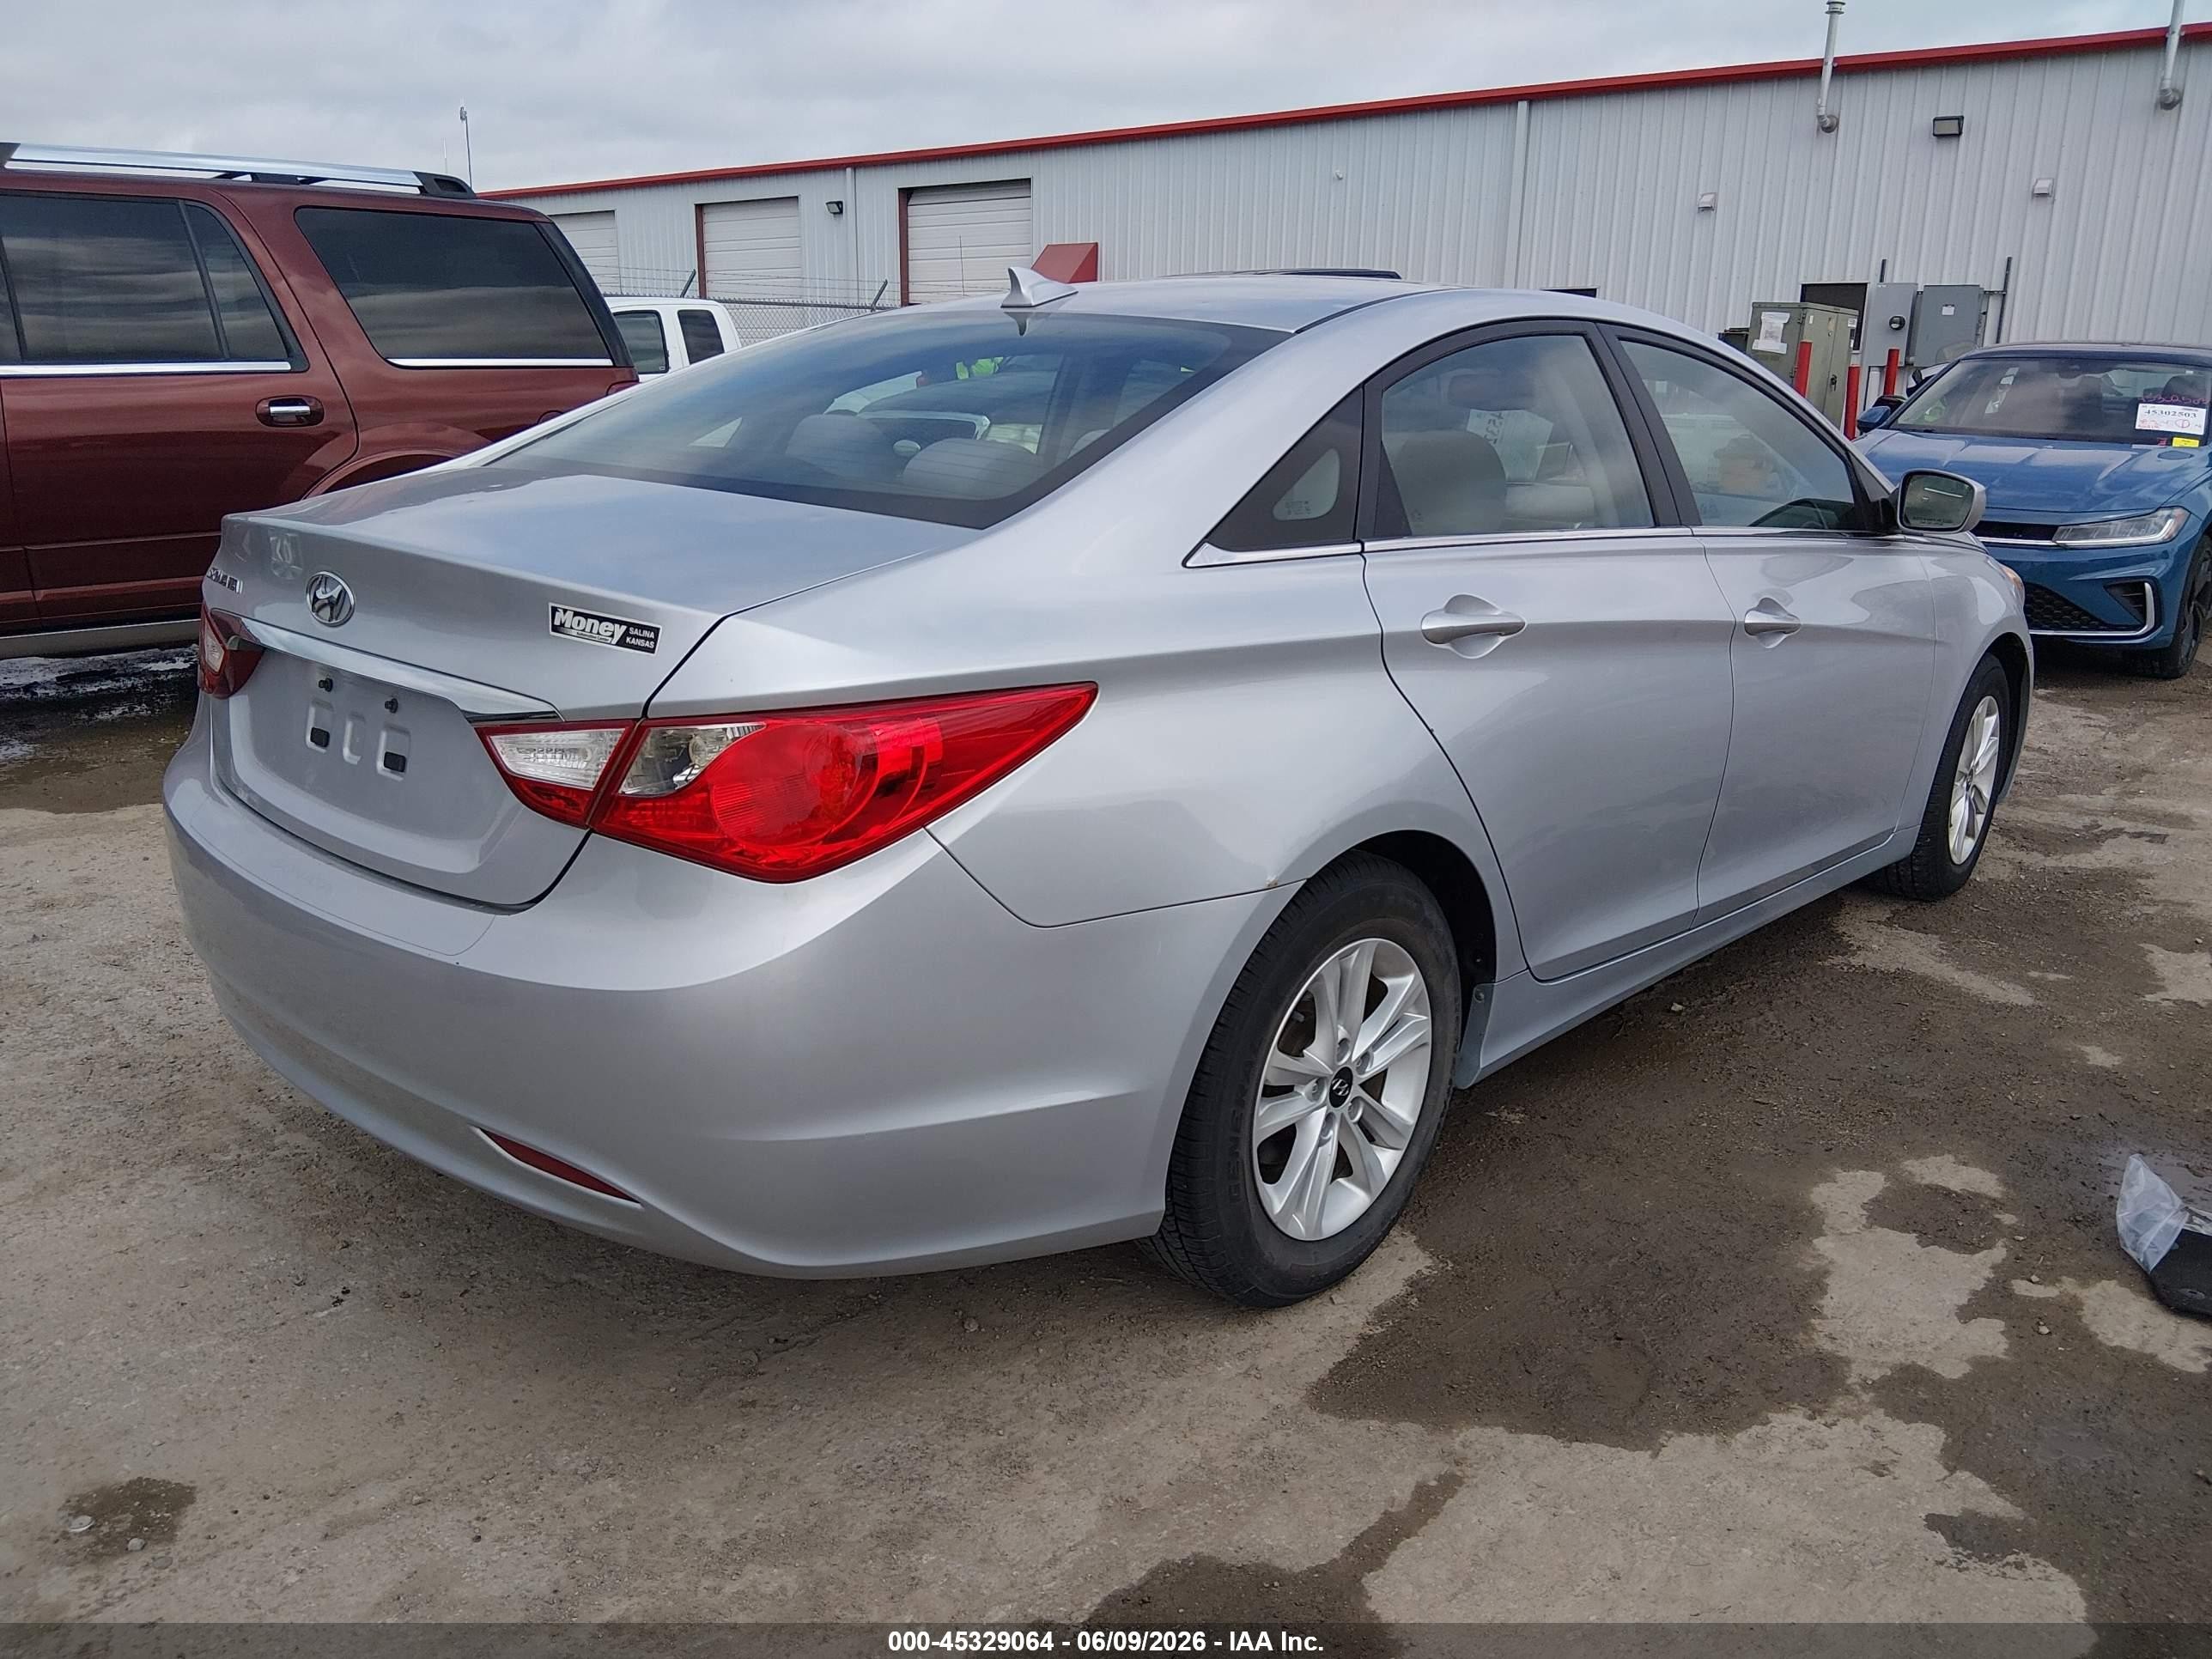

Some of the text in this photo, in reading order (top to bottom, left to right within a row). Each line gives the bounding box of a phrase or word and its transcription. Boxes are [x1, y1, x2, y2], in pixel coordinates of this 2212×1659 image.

[2144, 410, 2197, 418] 45302503
[554, 609, 627, 645] Money
[629, 627, 654, 639] SALINA
[626, 636, 654, 648] KANSAS
